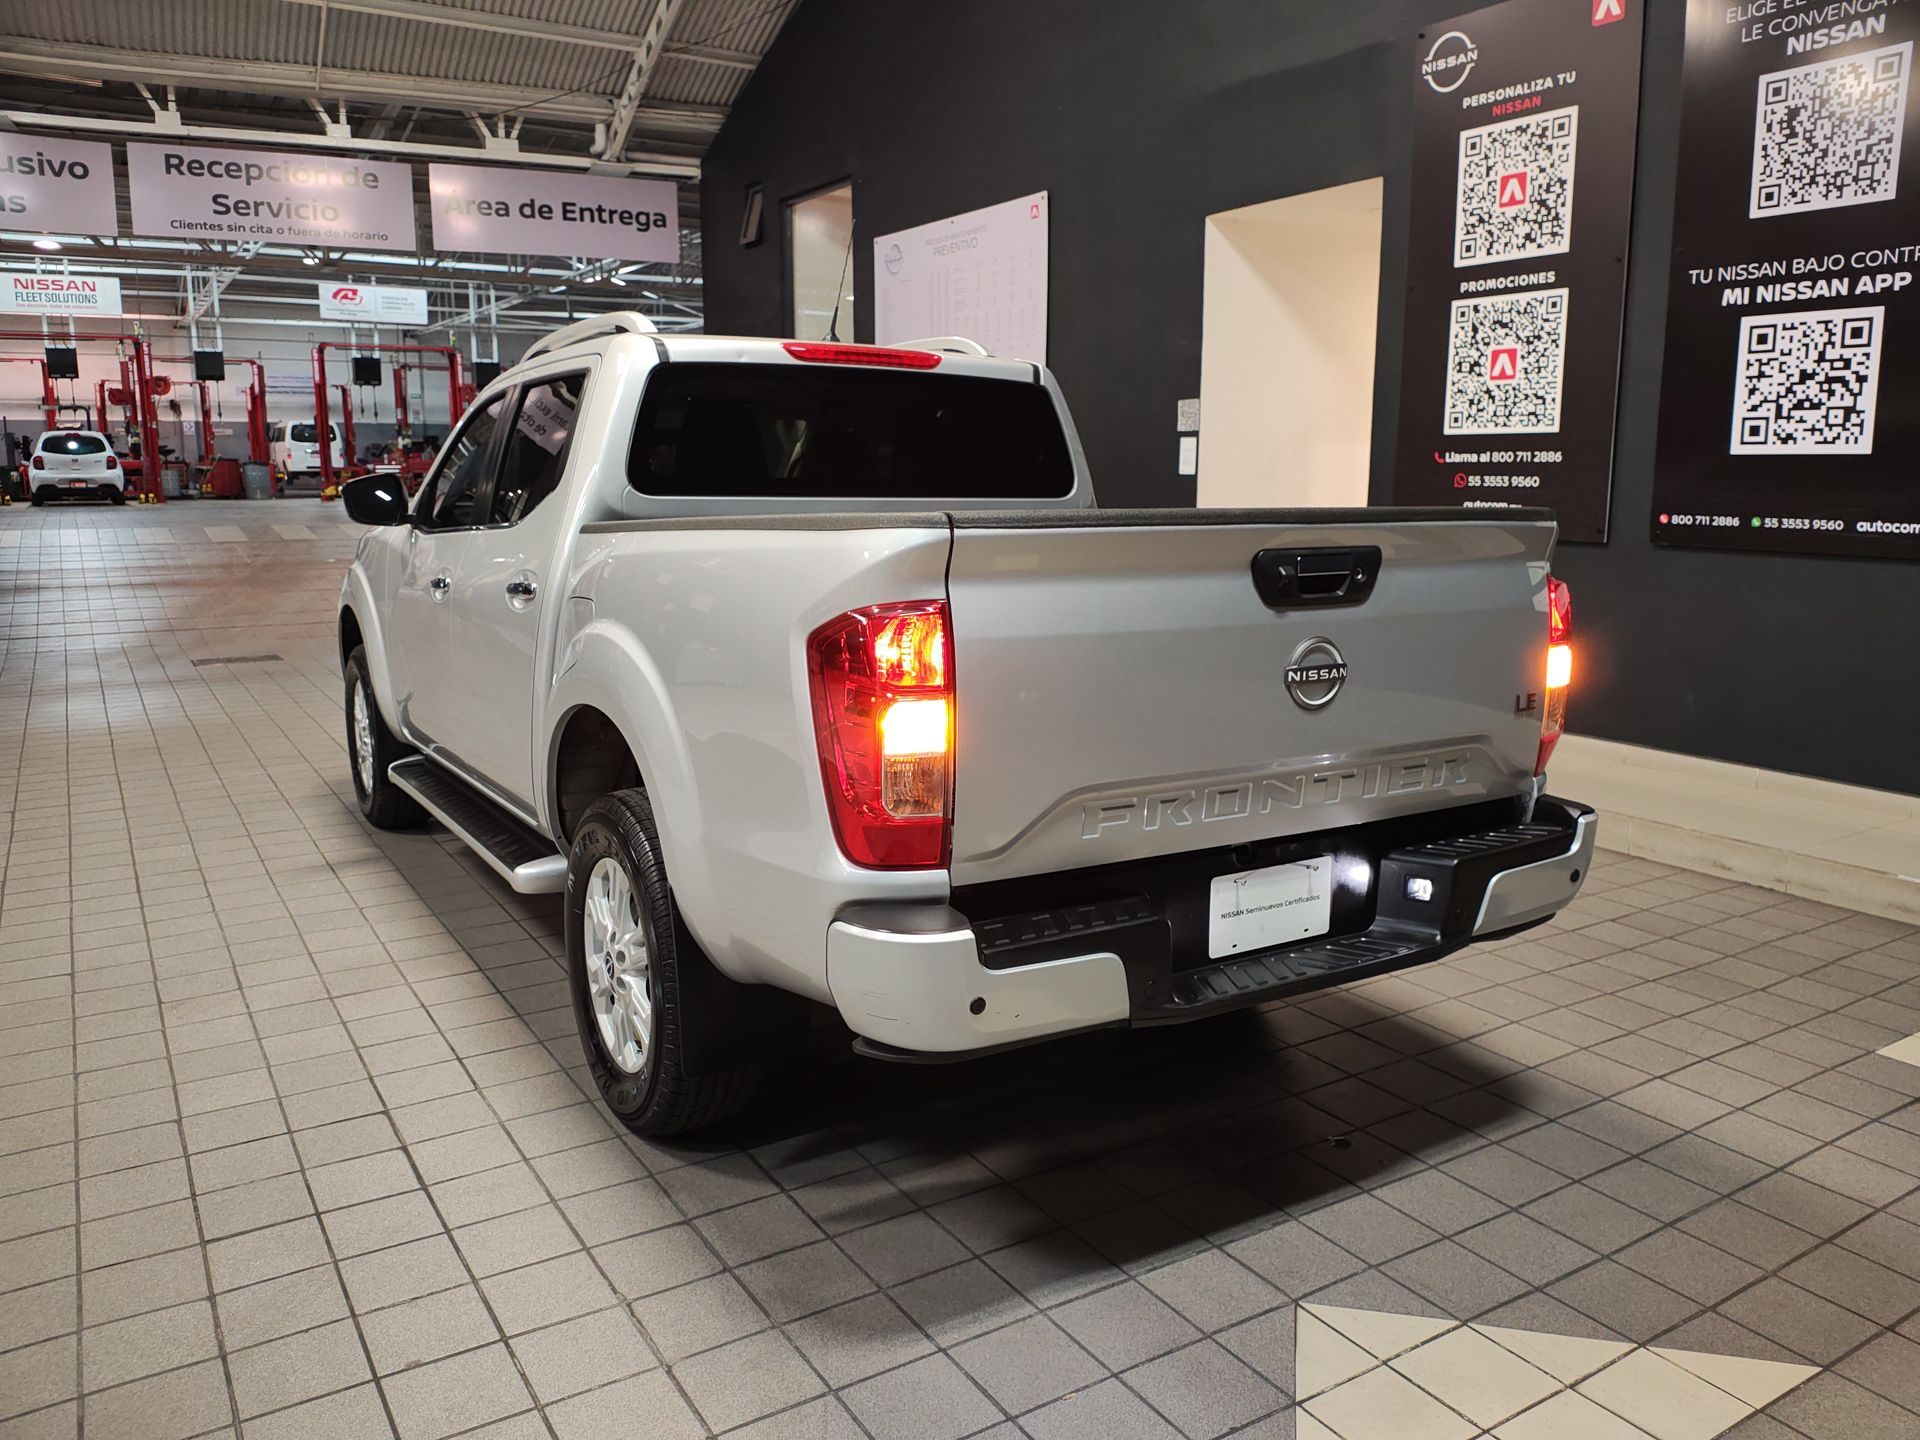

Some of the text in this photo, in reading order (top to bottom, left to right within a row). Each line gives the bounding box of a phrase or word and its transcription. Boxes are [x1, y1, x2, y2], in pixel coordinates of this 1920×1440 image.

[1727, 0, 1777, 24] ELIGE
[1741, 0, 1888, 43] LE CONVENGA
[1786, 14, 1886, 56] NISSAN
[1422, 49, 1478, 74] NISSAN
[1462, 71, 1576, 109] PERSONALIZA TU
[1492, 95, 1542, 117] NISSAN
[0, 152, 89, 179] usivo
[342, 166, 379, 189] de
[211, 193, 340, 222] Servicio
[518, 199, 553, 220] de
[562, 202, 667, 232] Entrega
[170, 219, 389, 242] Clientes sin cita o fuera de horario
[1689, 268, 1713, 285] TU
[1718, 260, 1787, 282] NISSAN
[1792, 254, 1845, 275] BAJO
[13, 278, 96, 292] NISSAN
[1460, 271, 1556, 294] PROMOCIONES
[1722, 271, 1913, 307] MI NISSAN APP
[15, 292, 98, 304] FLEET SOLUTIONS
[1445, 451, 1562, 463] Llama al 800 711 2886
[1468, 475, 1540, 487] 55 3553 9560
[1671, 514, 1740, 527] 800 711 2886
[1764, 517, 1844, 531] 55 3553 9560
[1288, 667, 1347, 682] NISSAN
[1515, 693, 1537, 712] LE
[1081, 752, 1471, 840] FRONTIER
[1220, 895, 1320, 919] NISSAN Seminuevos Certificados
